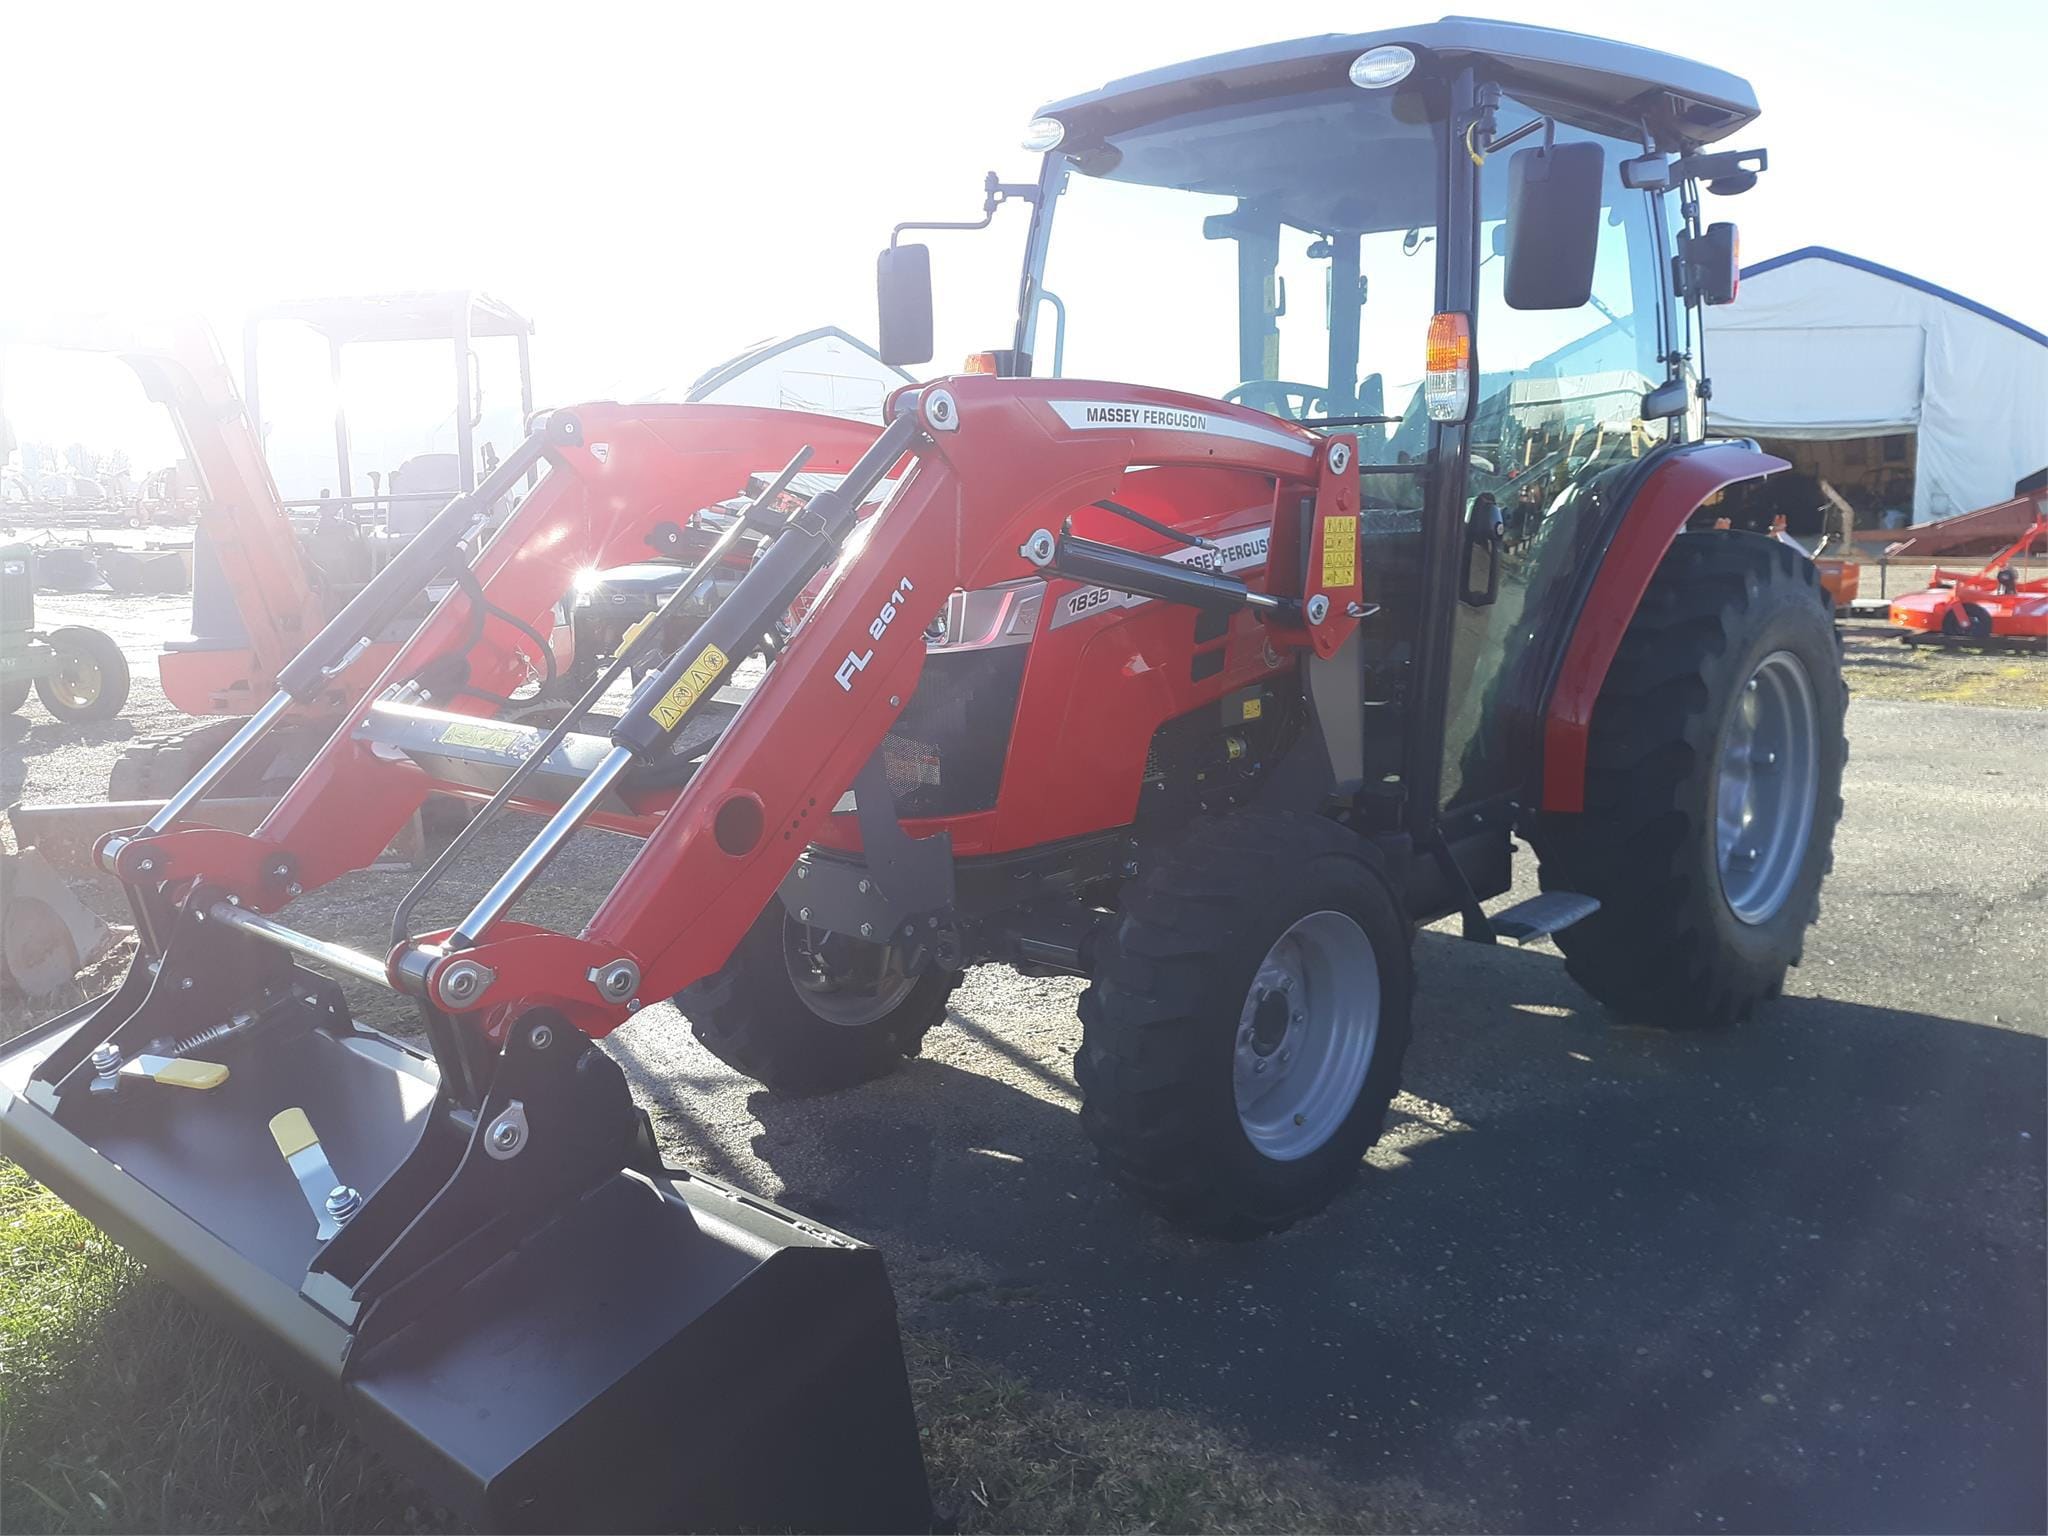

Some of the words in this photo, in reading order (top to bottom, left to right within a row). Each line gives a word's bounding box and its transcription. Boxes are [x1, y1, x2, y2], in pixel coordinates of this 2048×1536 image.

[1086, 407, 1139, 423] MASSEY
[1143, 410, 1207, 430] FERGUSON
[1221, 537, 1270, 564] FERGUS
[1068, 588, 1110, 614] 1835
[834, 649, 874, 692] FL
[869, 576, 914, 641] 2611
